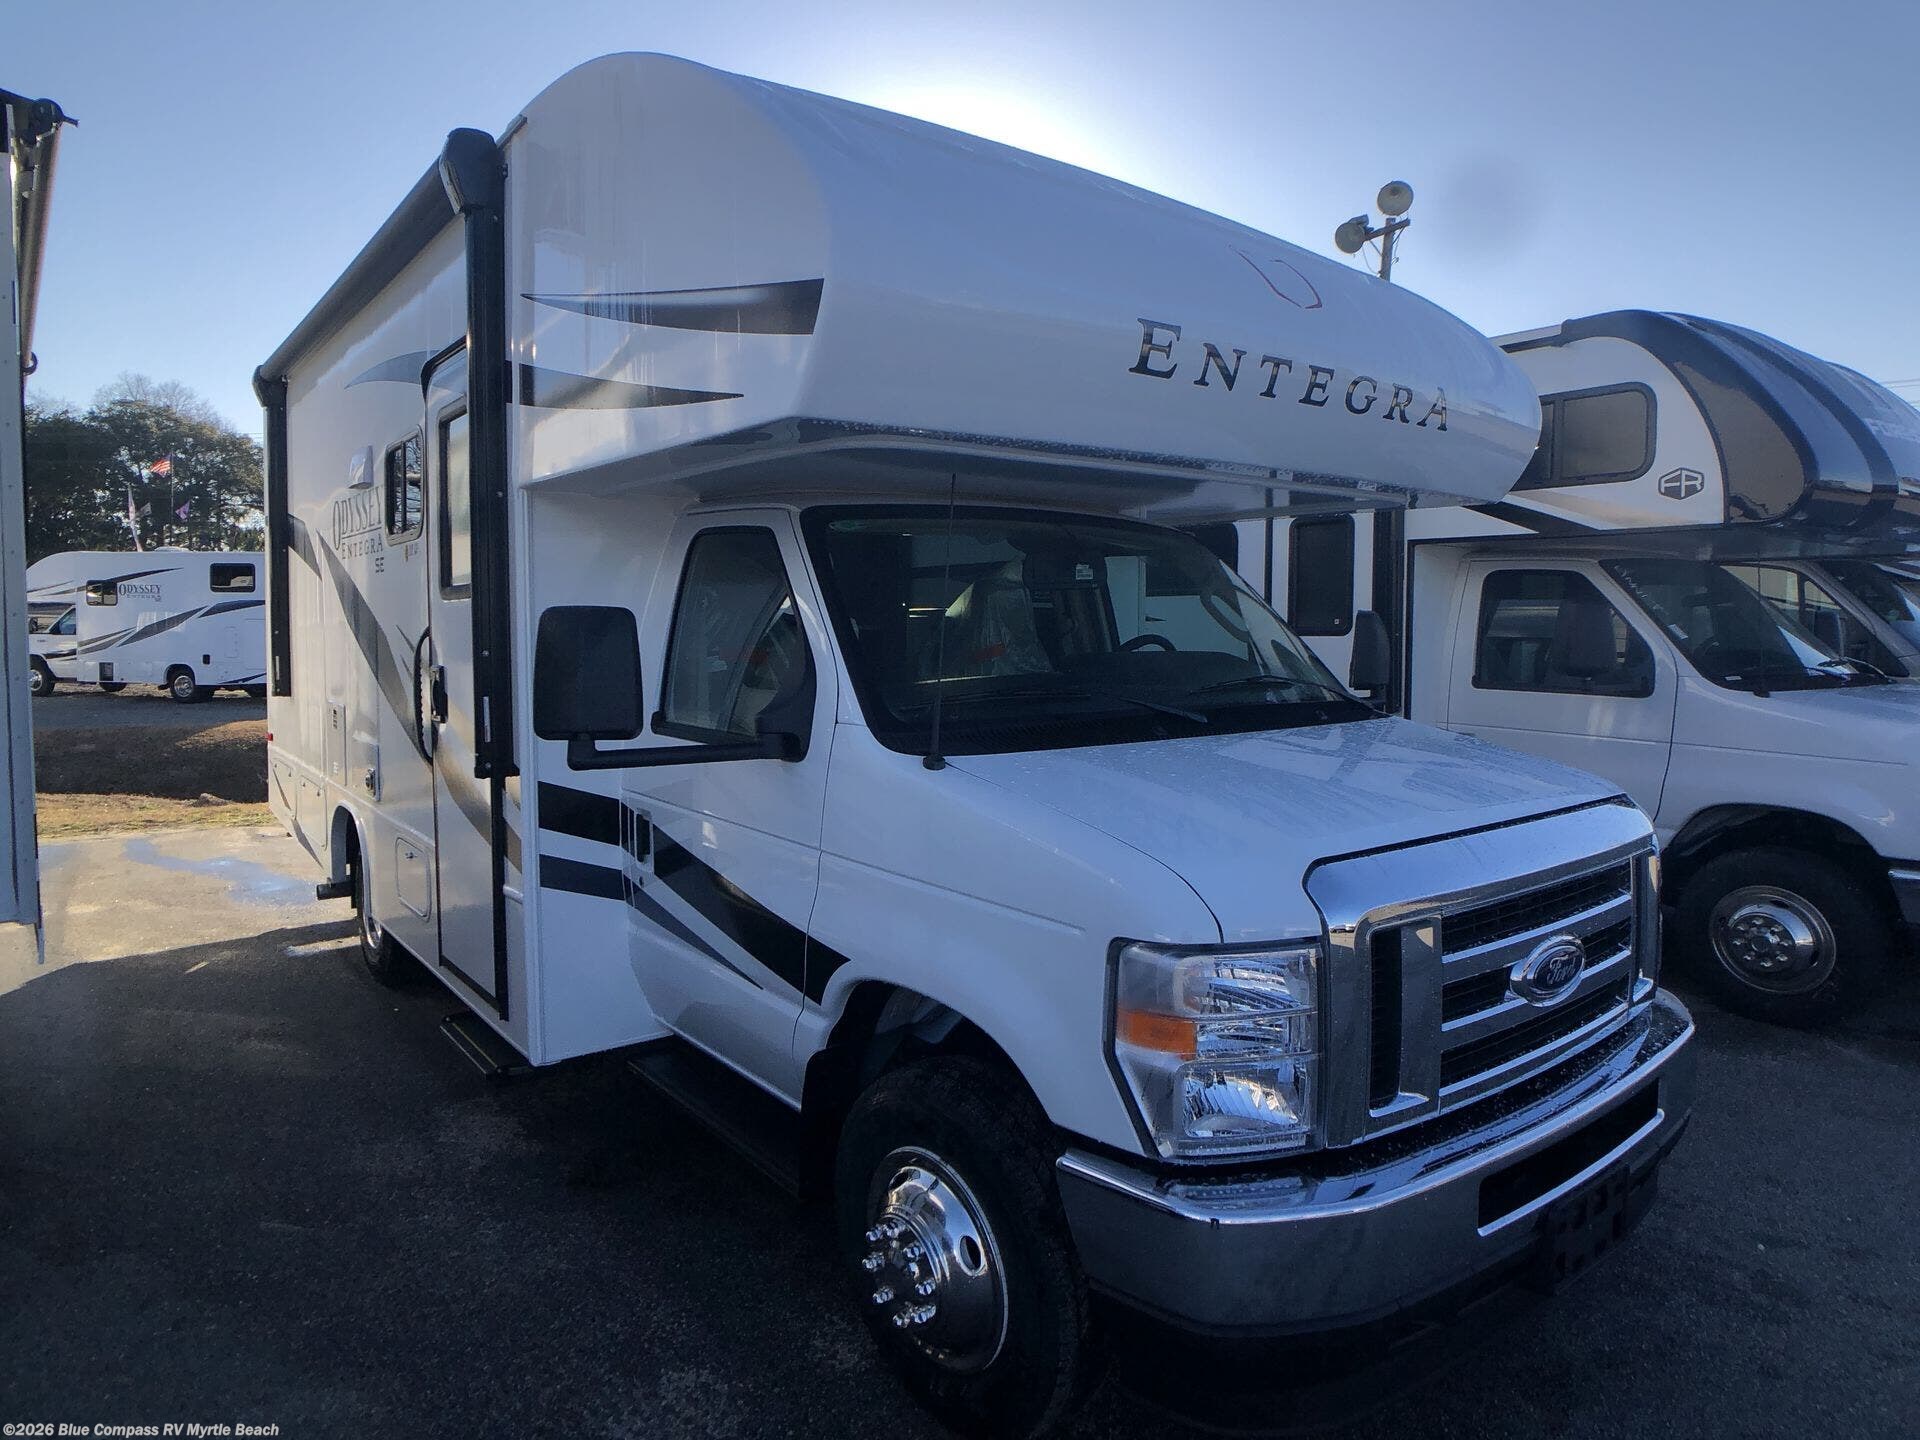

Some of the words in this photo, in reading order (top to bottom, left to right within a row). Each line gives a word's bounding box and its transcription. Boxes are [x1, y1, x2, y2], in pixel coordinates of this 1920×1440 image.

[1128, 317, 1449, 432] ENTEGRA
[333, 485, 384, 551] ODYSSEY
[341, 533, 384, 560] ENTEGRA
[374, 556, 385, 574] SE
[119, 583, 161, 596] ODYSSEY
[1545, 954, 1577, 985] Ford
